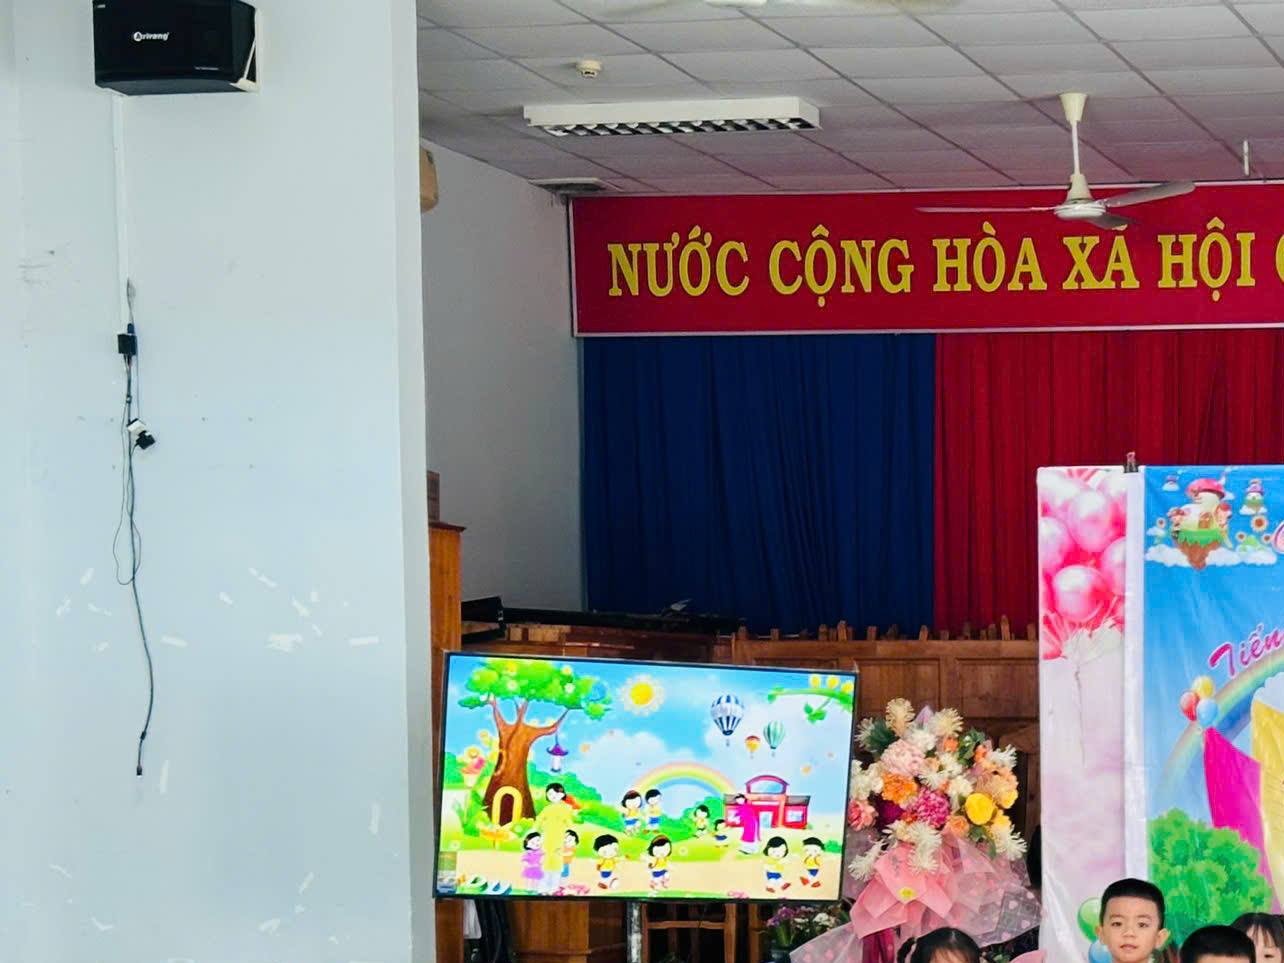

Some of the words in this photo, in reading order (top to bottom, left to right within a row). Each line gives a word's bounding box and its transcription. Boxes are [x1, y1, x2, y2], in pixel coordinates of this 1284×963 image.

[606, 225, 749, 297] NƯỚC
[768, 224, 915, 308] CỘNG
[931, 220, 1048, 294] HÒA
[1156, 216, 1257, 302] HỘI
